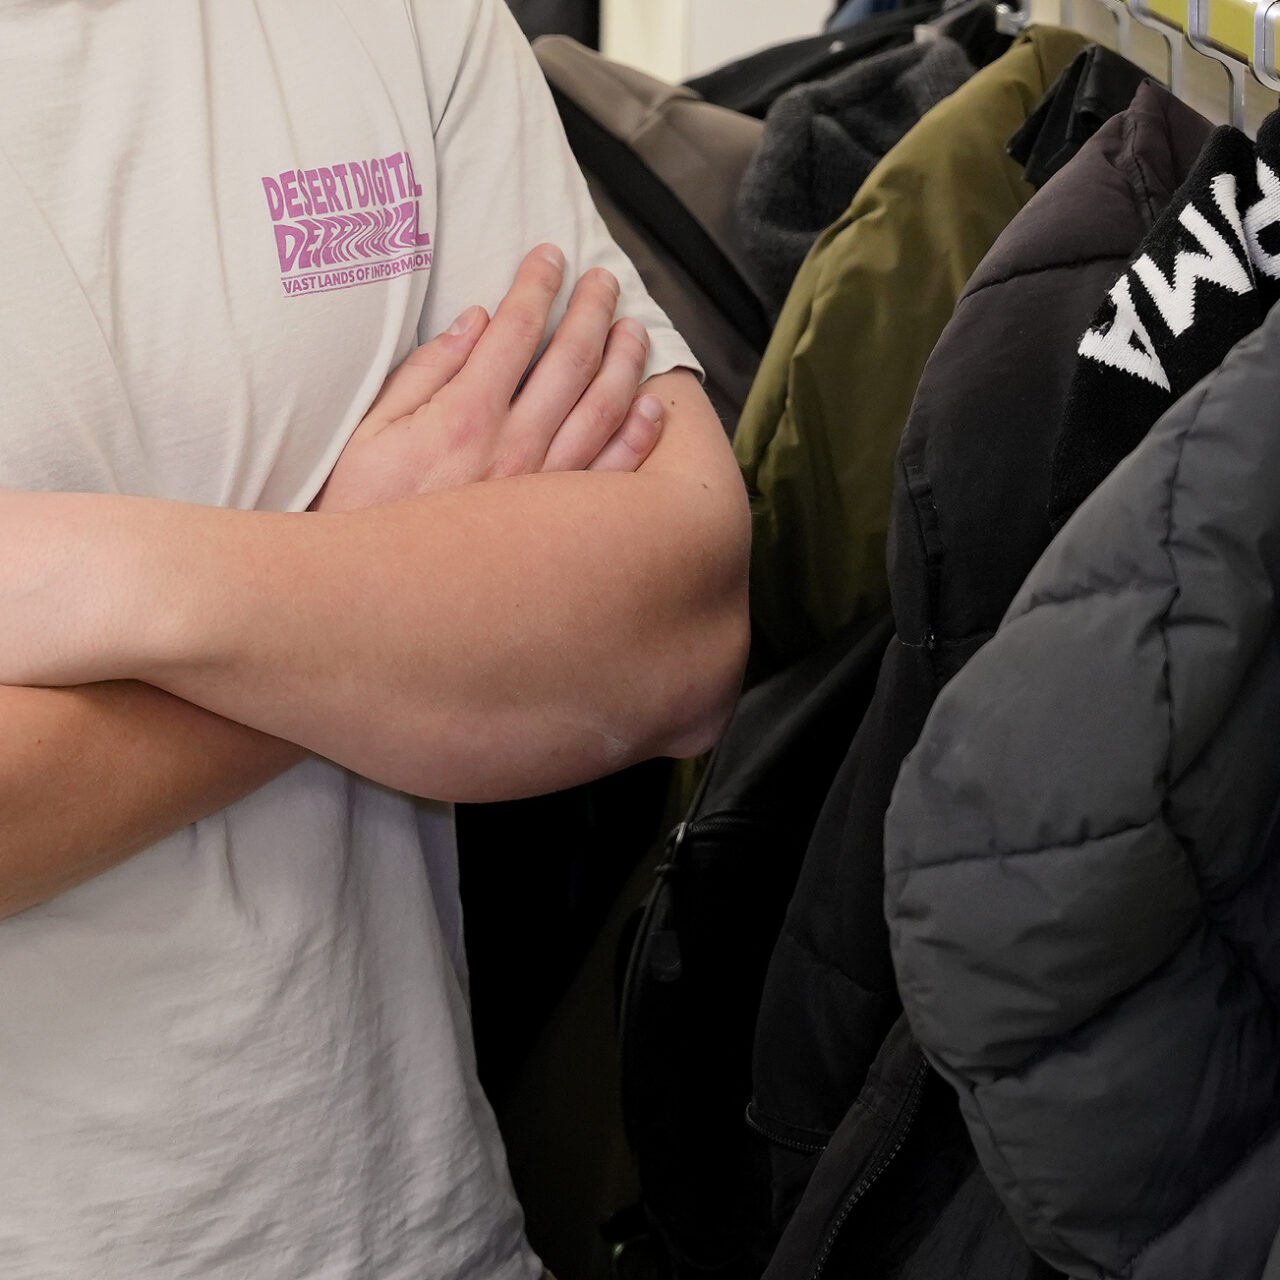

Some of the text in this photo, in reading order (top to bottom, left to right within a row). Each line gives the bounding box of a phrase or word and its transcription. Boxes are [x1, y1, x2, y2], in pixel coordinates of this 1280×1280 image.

[261, 164, 353, 221] DESERT
[282, 276, 316, 294] VAST
[317, 270, 355, 288] LANDS
[356, 267, 371, 281] OF
